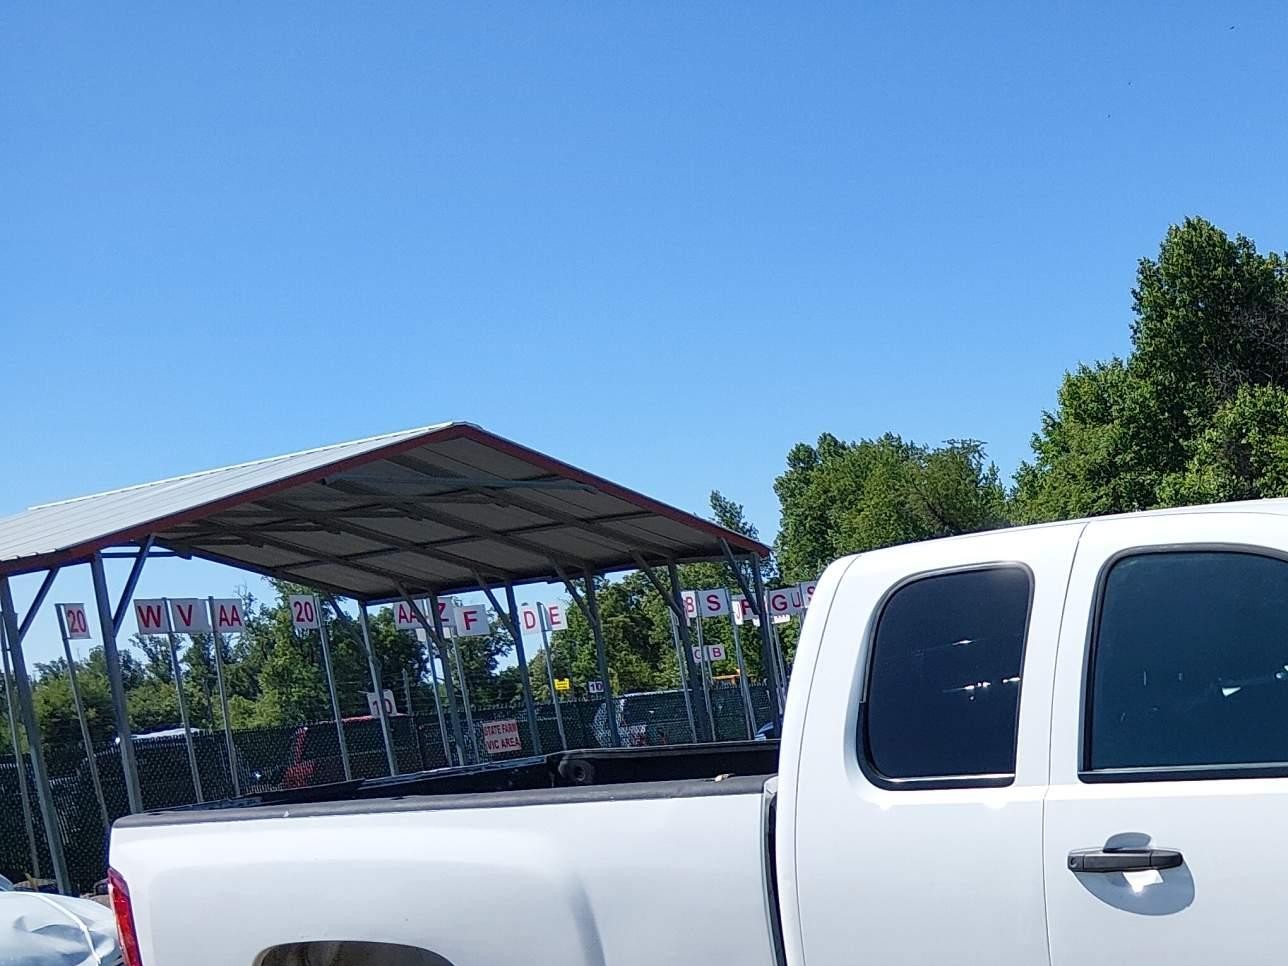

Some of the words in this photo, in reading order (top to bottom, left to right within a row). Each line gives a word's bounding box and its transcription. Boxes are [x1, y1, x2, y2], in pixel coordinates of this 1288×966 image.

[294, 601, 314, 623] 20
[706, 594, 722, 611] S
[771, 594, 788, 612] G
[67, 609, 87, 633] 20
[137, 605, 162, 628] W
[176, 605, 193, 627] V
[218, 605, 242, 627] AA
[463, 610, 478, 631] F
[523, 610, 536, 629] D
[548, 606, 561, 625] E
[712, 647, 722, 658] B
[590, 683, 603, 692] 10
[372, 698, 393, 714] 10
[483, 724, 502, 737] STATE
[501, 722, 517, 734] FARM
[486, 739, 500, 750] VIC
[501, 736, 521, 749] AREA
